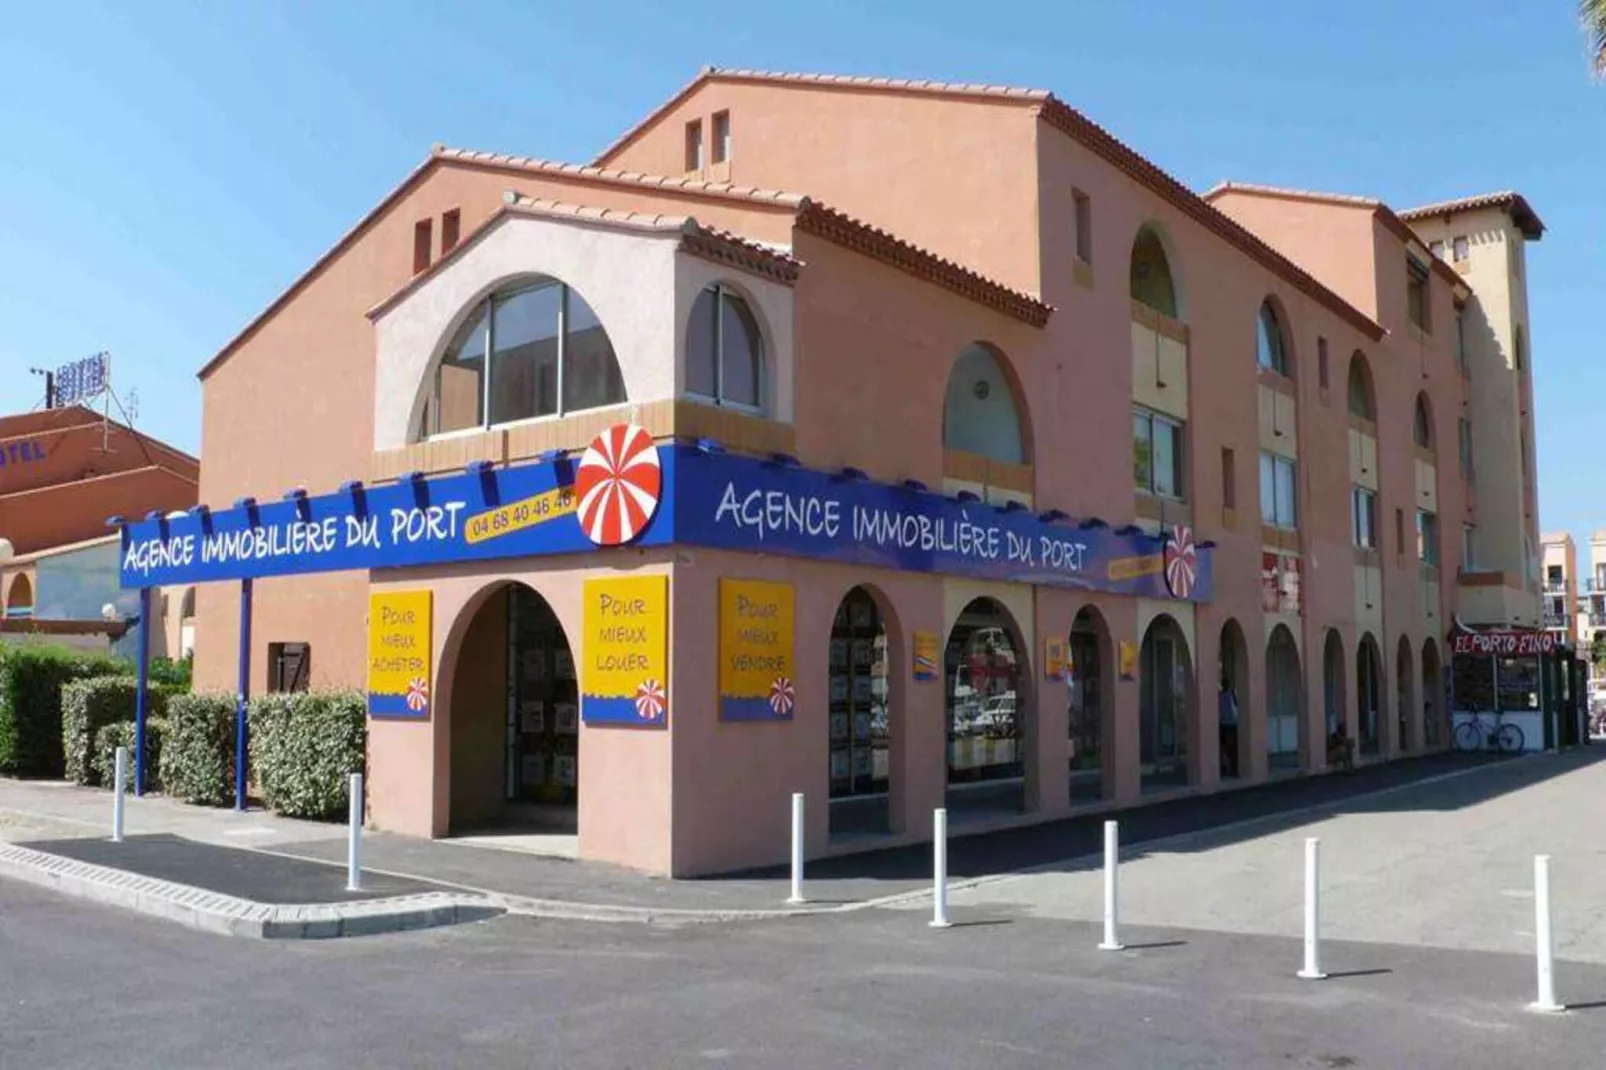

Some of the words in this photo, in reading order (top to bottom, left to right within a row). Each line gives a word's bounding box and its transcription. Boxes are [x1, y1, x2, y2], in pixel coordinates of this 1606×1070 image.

[473, 517, 488, 536] 04
[493, 511, 509, 530] 68
[513, 505, 529, 523] 40
[533, 498, 549, 516] 46
[715, 481, 840, 542] AGENCE
[852, 505, 999, 559] IMMOBILIÈRE
[1006, 530, 1034, 567] DU
[1040, 536, 1086, 571] PORT
[123, 535, 194, 577] AGENCE
[201, 508, 337, 562] IMMOBILIÈRE
[345, 514, 381, 549] DU
[391, 502, 466, 545] PORT
[600, 593, 647, 616] POUR
[737, 593, 778, 618] POUR
[382, 605, 415, 627] POUR
[381, 633, 416, 649] MIEUX
[599, 626, 647, 643] MIEUX
[737, 627, 779, 644] MIEUX
[1455, 635, 1470, 653] EL
[1471, 634, 1517, 653] PORTO
[372, 656, 425, 672] ACHETER
[596, 653, 650, 672] LOUER
[730, 654, 785, 671] VENDRE
